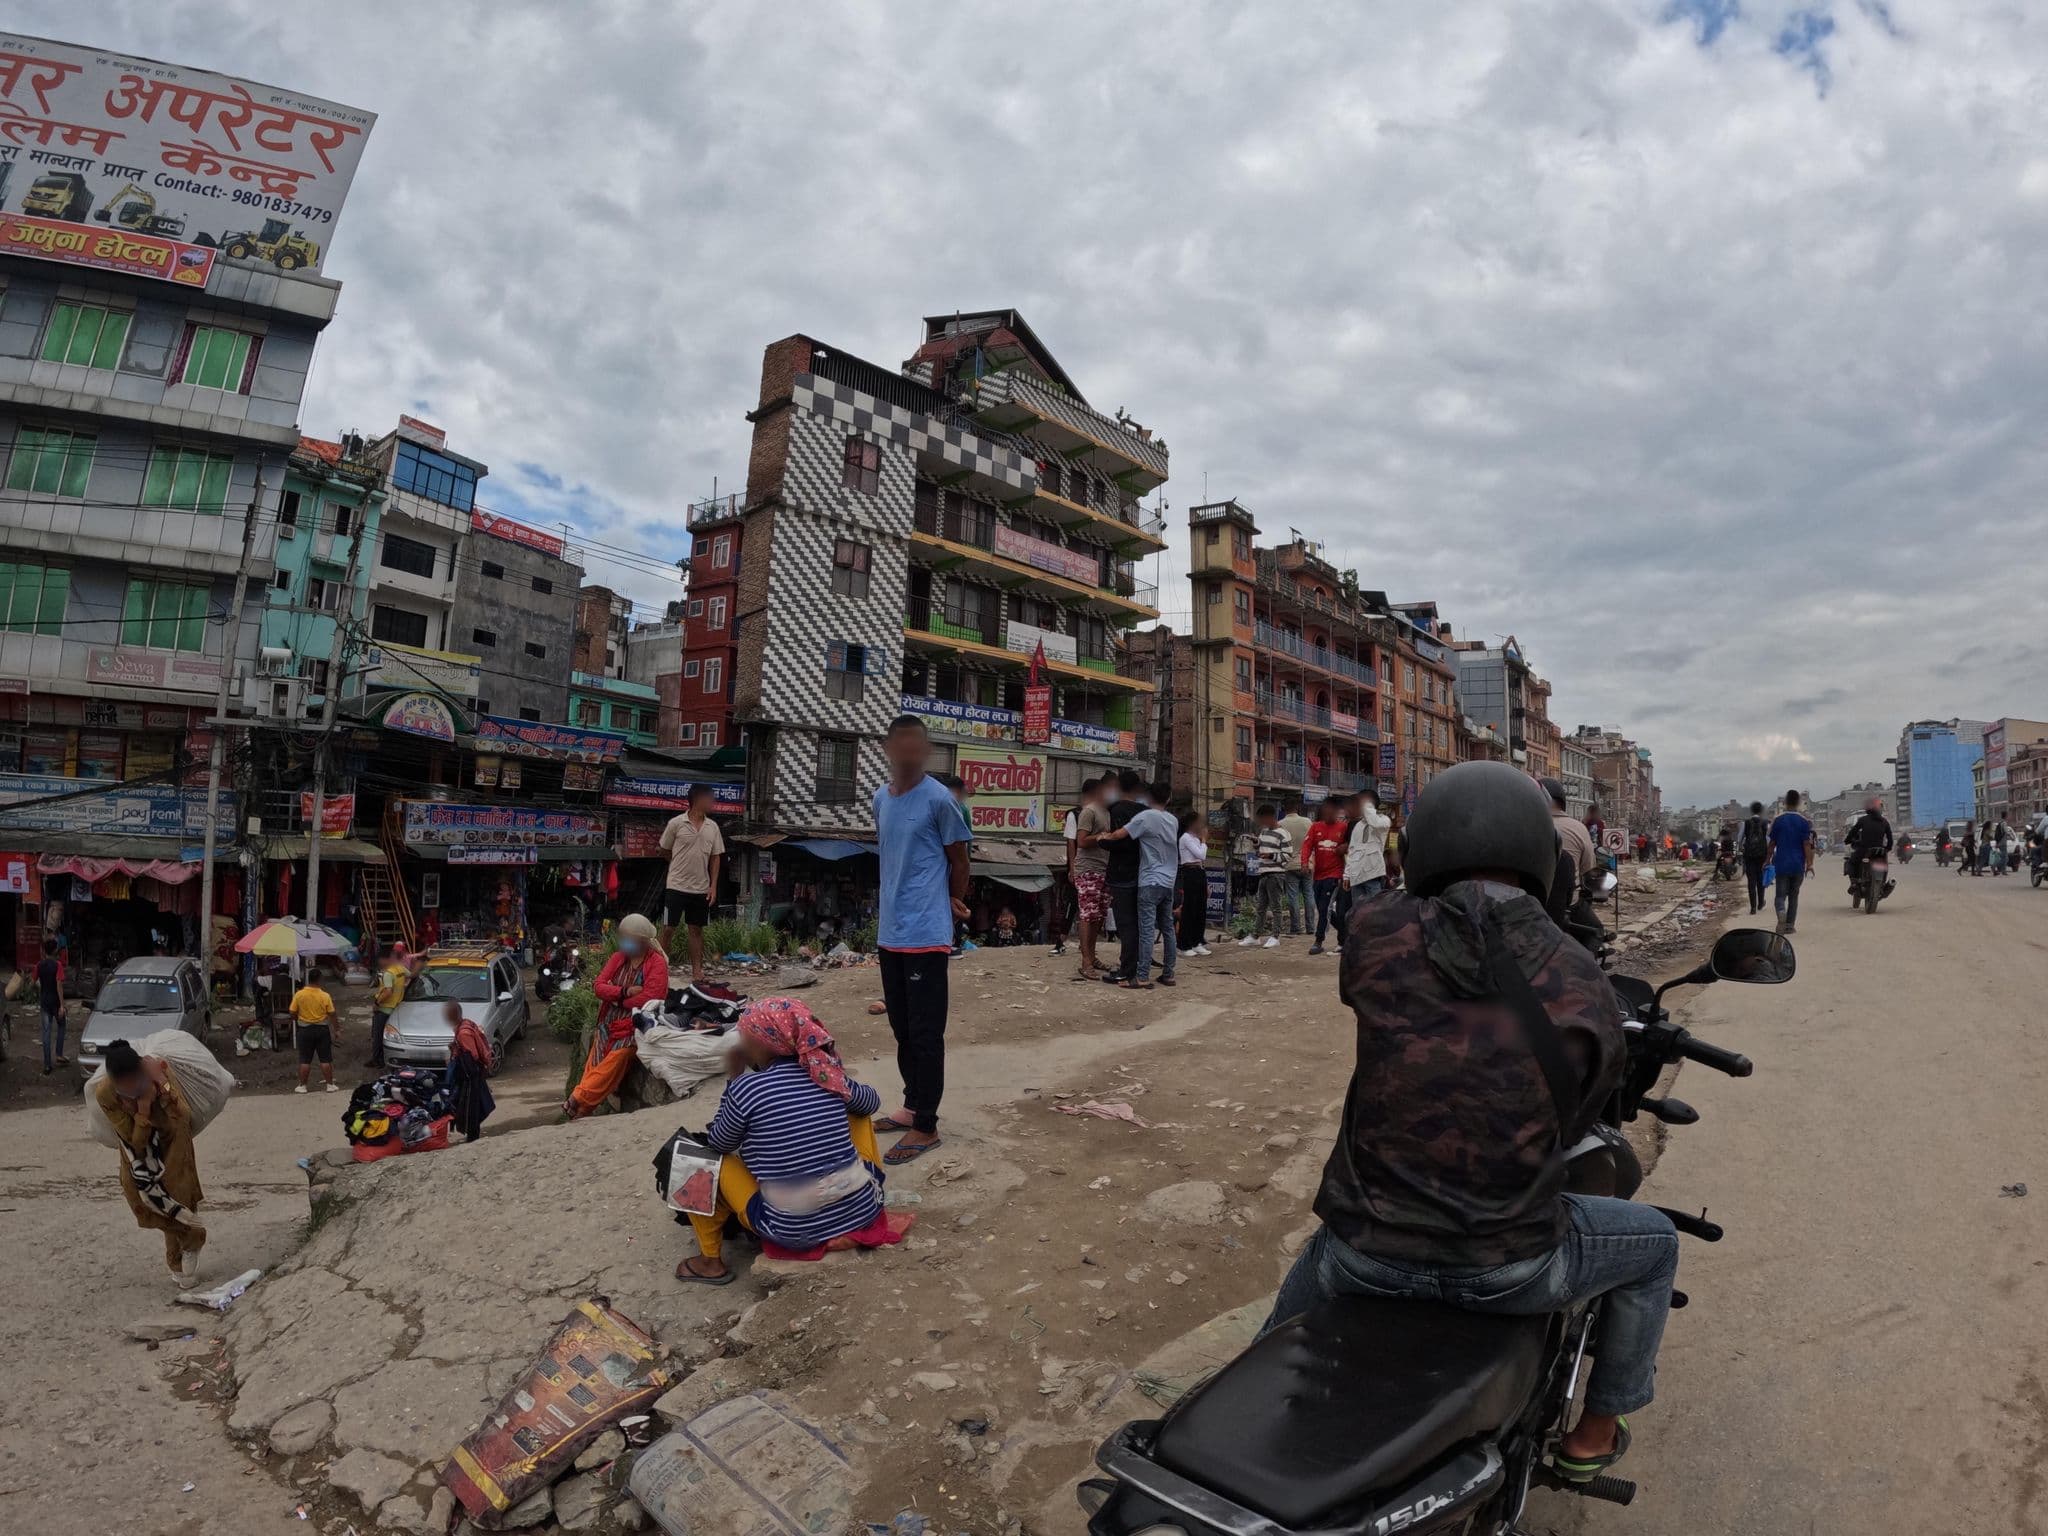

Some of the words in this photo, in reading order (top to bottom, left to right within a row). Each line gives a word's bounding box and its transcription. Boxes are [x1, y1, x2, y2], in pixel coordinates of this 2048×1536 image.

[104, 74, 361, 174] अपरेटर
[30, 149, 96, 172] मान्यता
[102, 162, 148, 182] प्राप्त
[154, 172, 228, 199] Contact:-
[231, 189, 333, 224] 9801837479
[160, 139, 316, 200] केन्द्र
[8, 222, 91, 253] जमुना
[93, 233, 172, 267] होटल
[902, 695, 931, 711] रोयल
[933, 700, 963, 716] गोरखा
[965, 705, 990, 720] होटल
[972, 806, 1006, 829] डान्स
[1008, 807, 1030, 829] बार
[1374, 1493, 1437, 1536] 150
